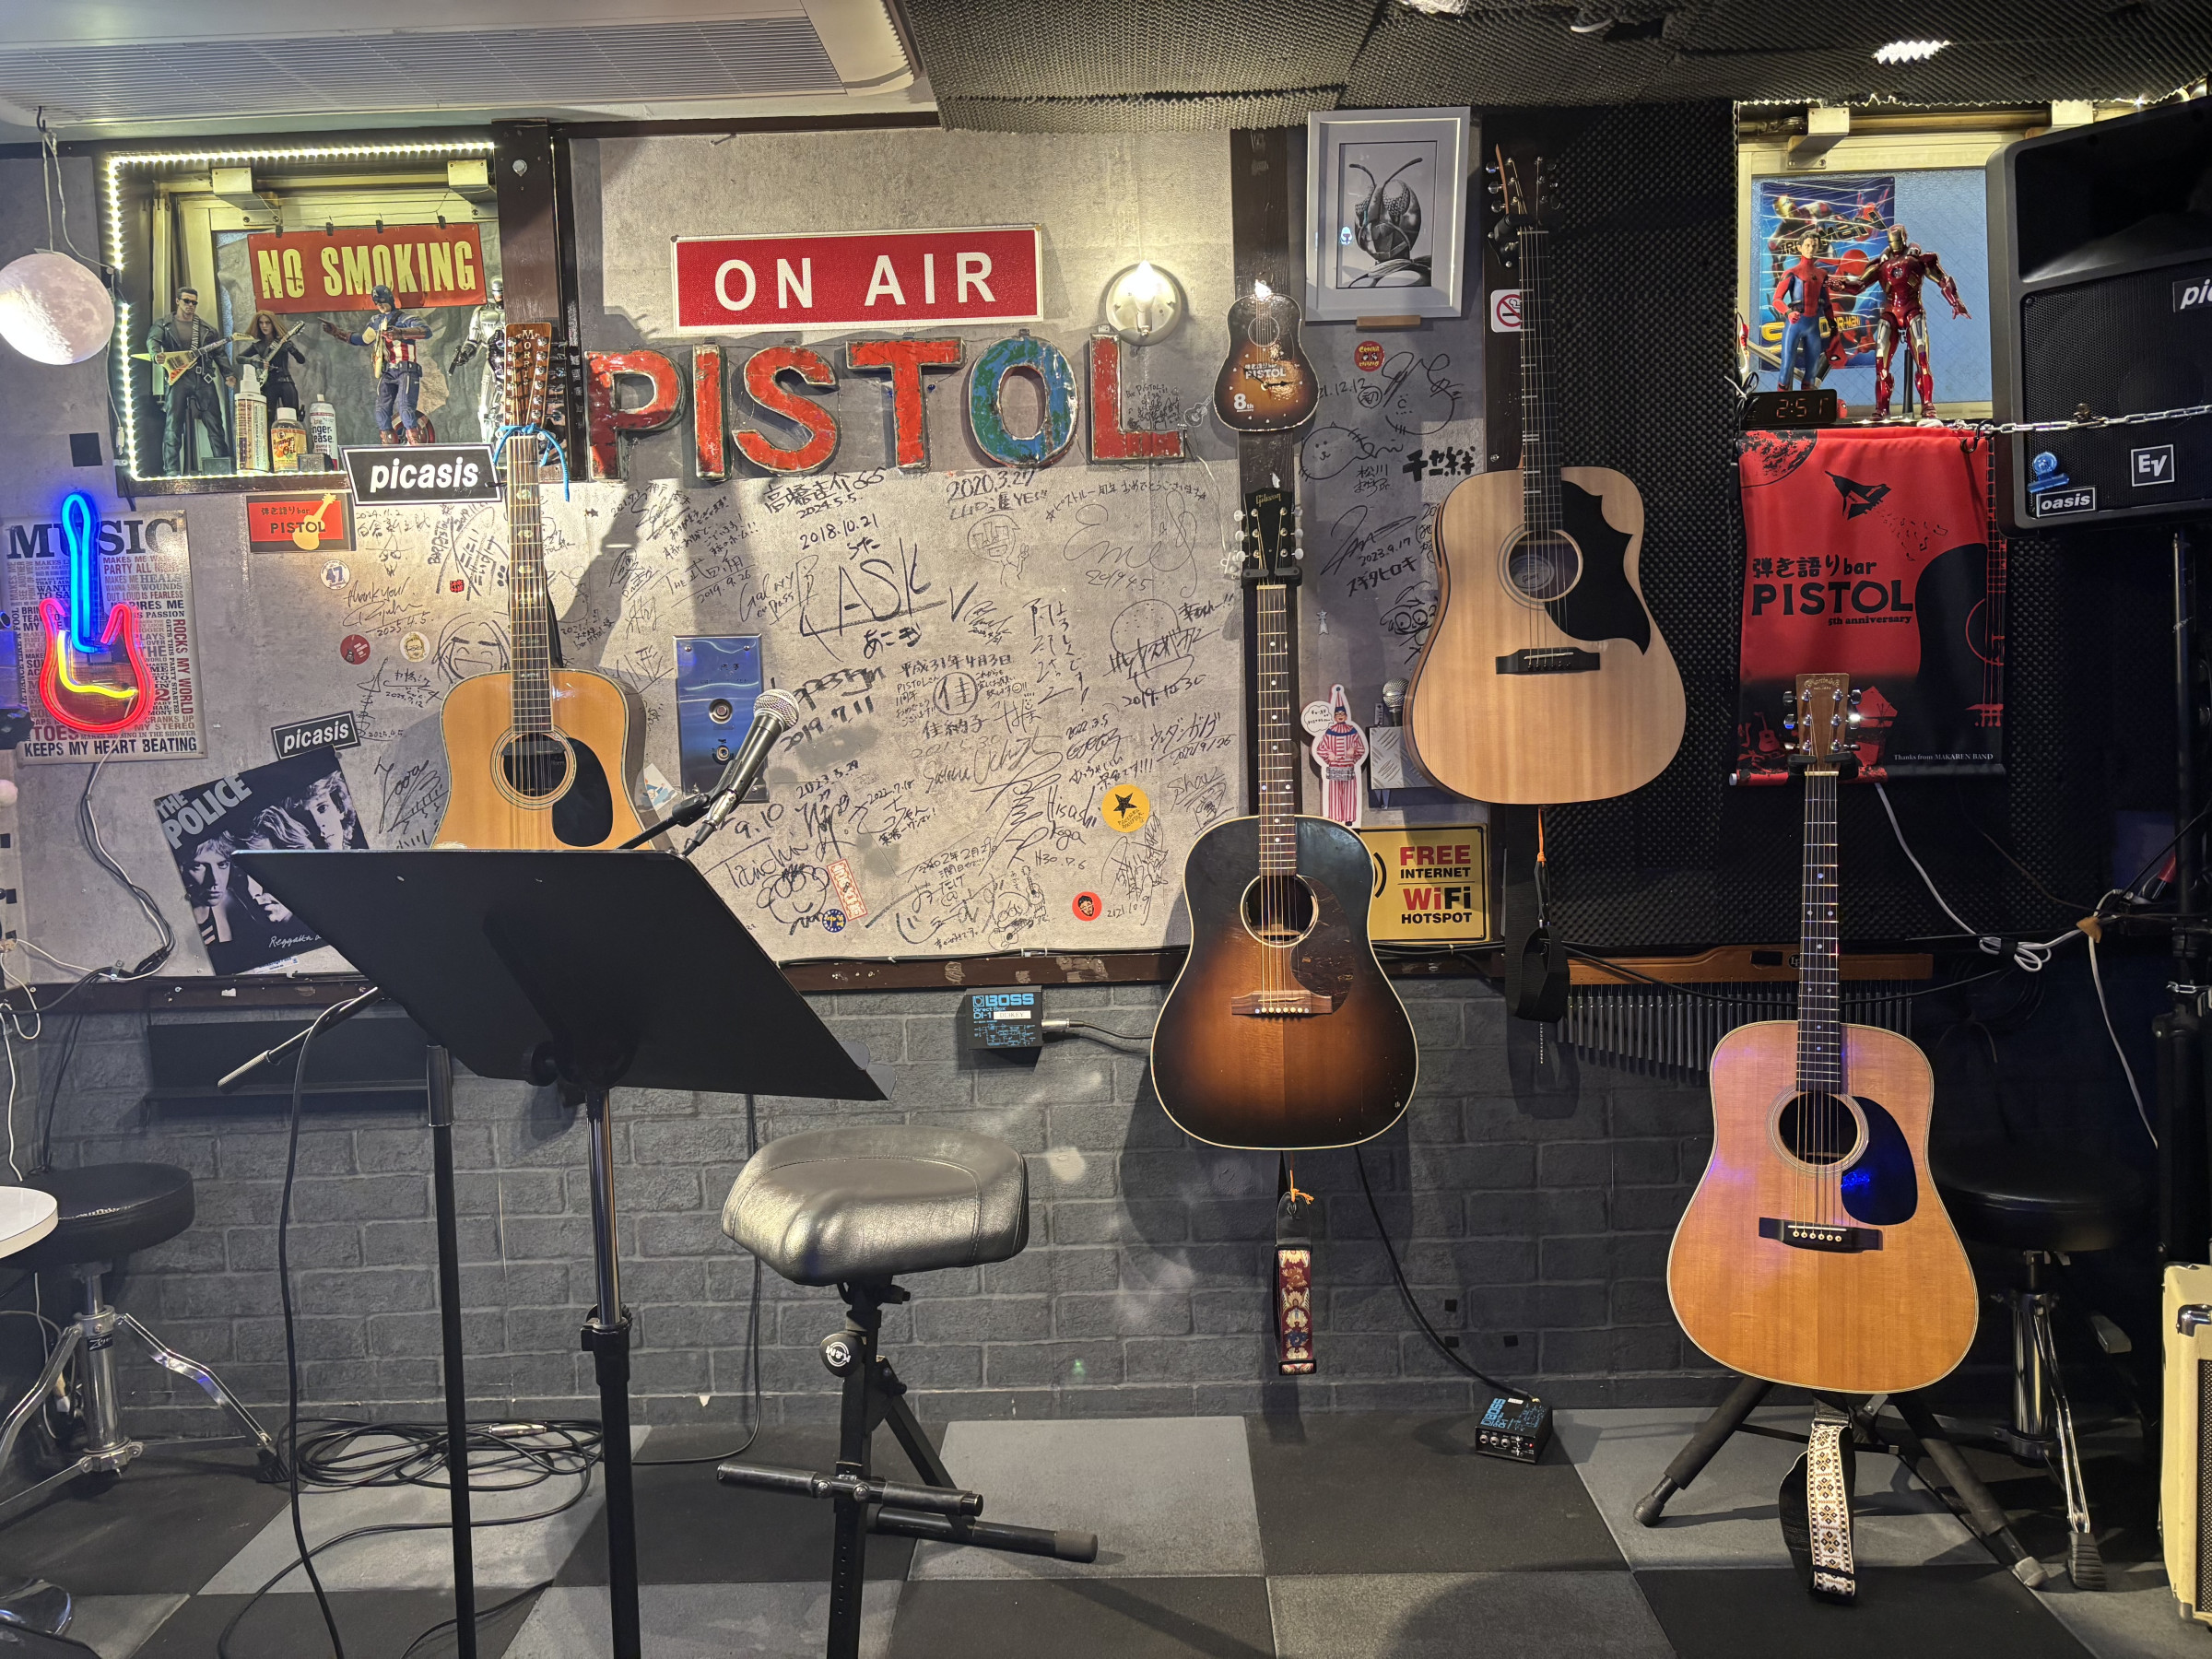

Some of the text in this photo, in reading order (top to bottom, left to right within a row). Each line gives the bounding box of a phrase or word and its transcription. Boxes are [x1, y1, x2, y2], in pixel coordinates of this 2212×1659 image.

[257, 241, 477, 299] NO SMOKING
[714, 252, 996, 311] ON AIR
[522, 329, 535, 385] MORRIS
[1245, 368, 1287, 380] PISTOL
[586, 333, 1186, 482] PISTOL
[371, 457, 480, 493] picasis
[1256, 493, 1282, 507] Gibson
[2041, 492, 2091, 511] oasis
[270, 520, 326, 534] PISTOL
[799, 513, 879, 551] 2018.10.21
[103, 556, 132, 564] MAKES
[1752, 553, 1877, 579] 弾き語りbar
[104, 563, 132, 574] PARTY
[136, 562, 151, 573] ALL
[140, 573, 182, 583] HEALS
[140, 582, 183, 591] WOUNDS
[150, 590, 183, 599] FEARLESS
[1751, 579, 1914, 617] PISTOL
[167, 599, 184, 609] ME
[146, 610, 185, 618] PASSION
[1828, 615, 1912, 626] 5th anniversary
[173, 618, 194, 714] ROCKS MY WORLD
[155, 688, 171, 701] 2
[171, 682, 180, 714] STARTED
[146, 714, 194, 724] CRANKS UP
[134, 723, 195, 732] MY STEREO
[283, 720, 350, 754] picasis
[24, 736, 197, 758] KEEPS MY HEART BEATING
[157, 773, 253, 850] THE POLICE
[1399, 844, 1472, 865] FREE
[1400, 867, 1472, 879] INTERNET
[1403, 886, 1472, 911] WiFi
[1401, 912, 1473, 924] HOTSPOT
[268, 934, 313, 947] Reggatta
[984, 993, 1035, 1007] BOSS
